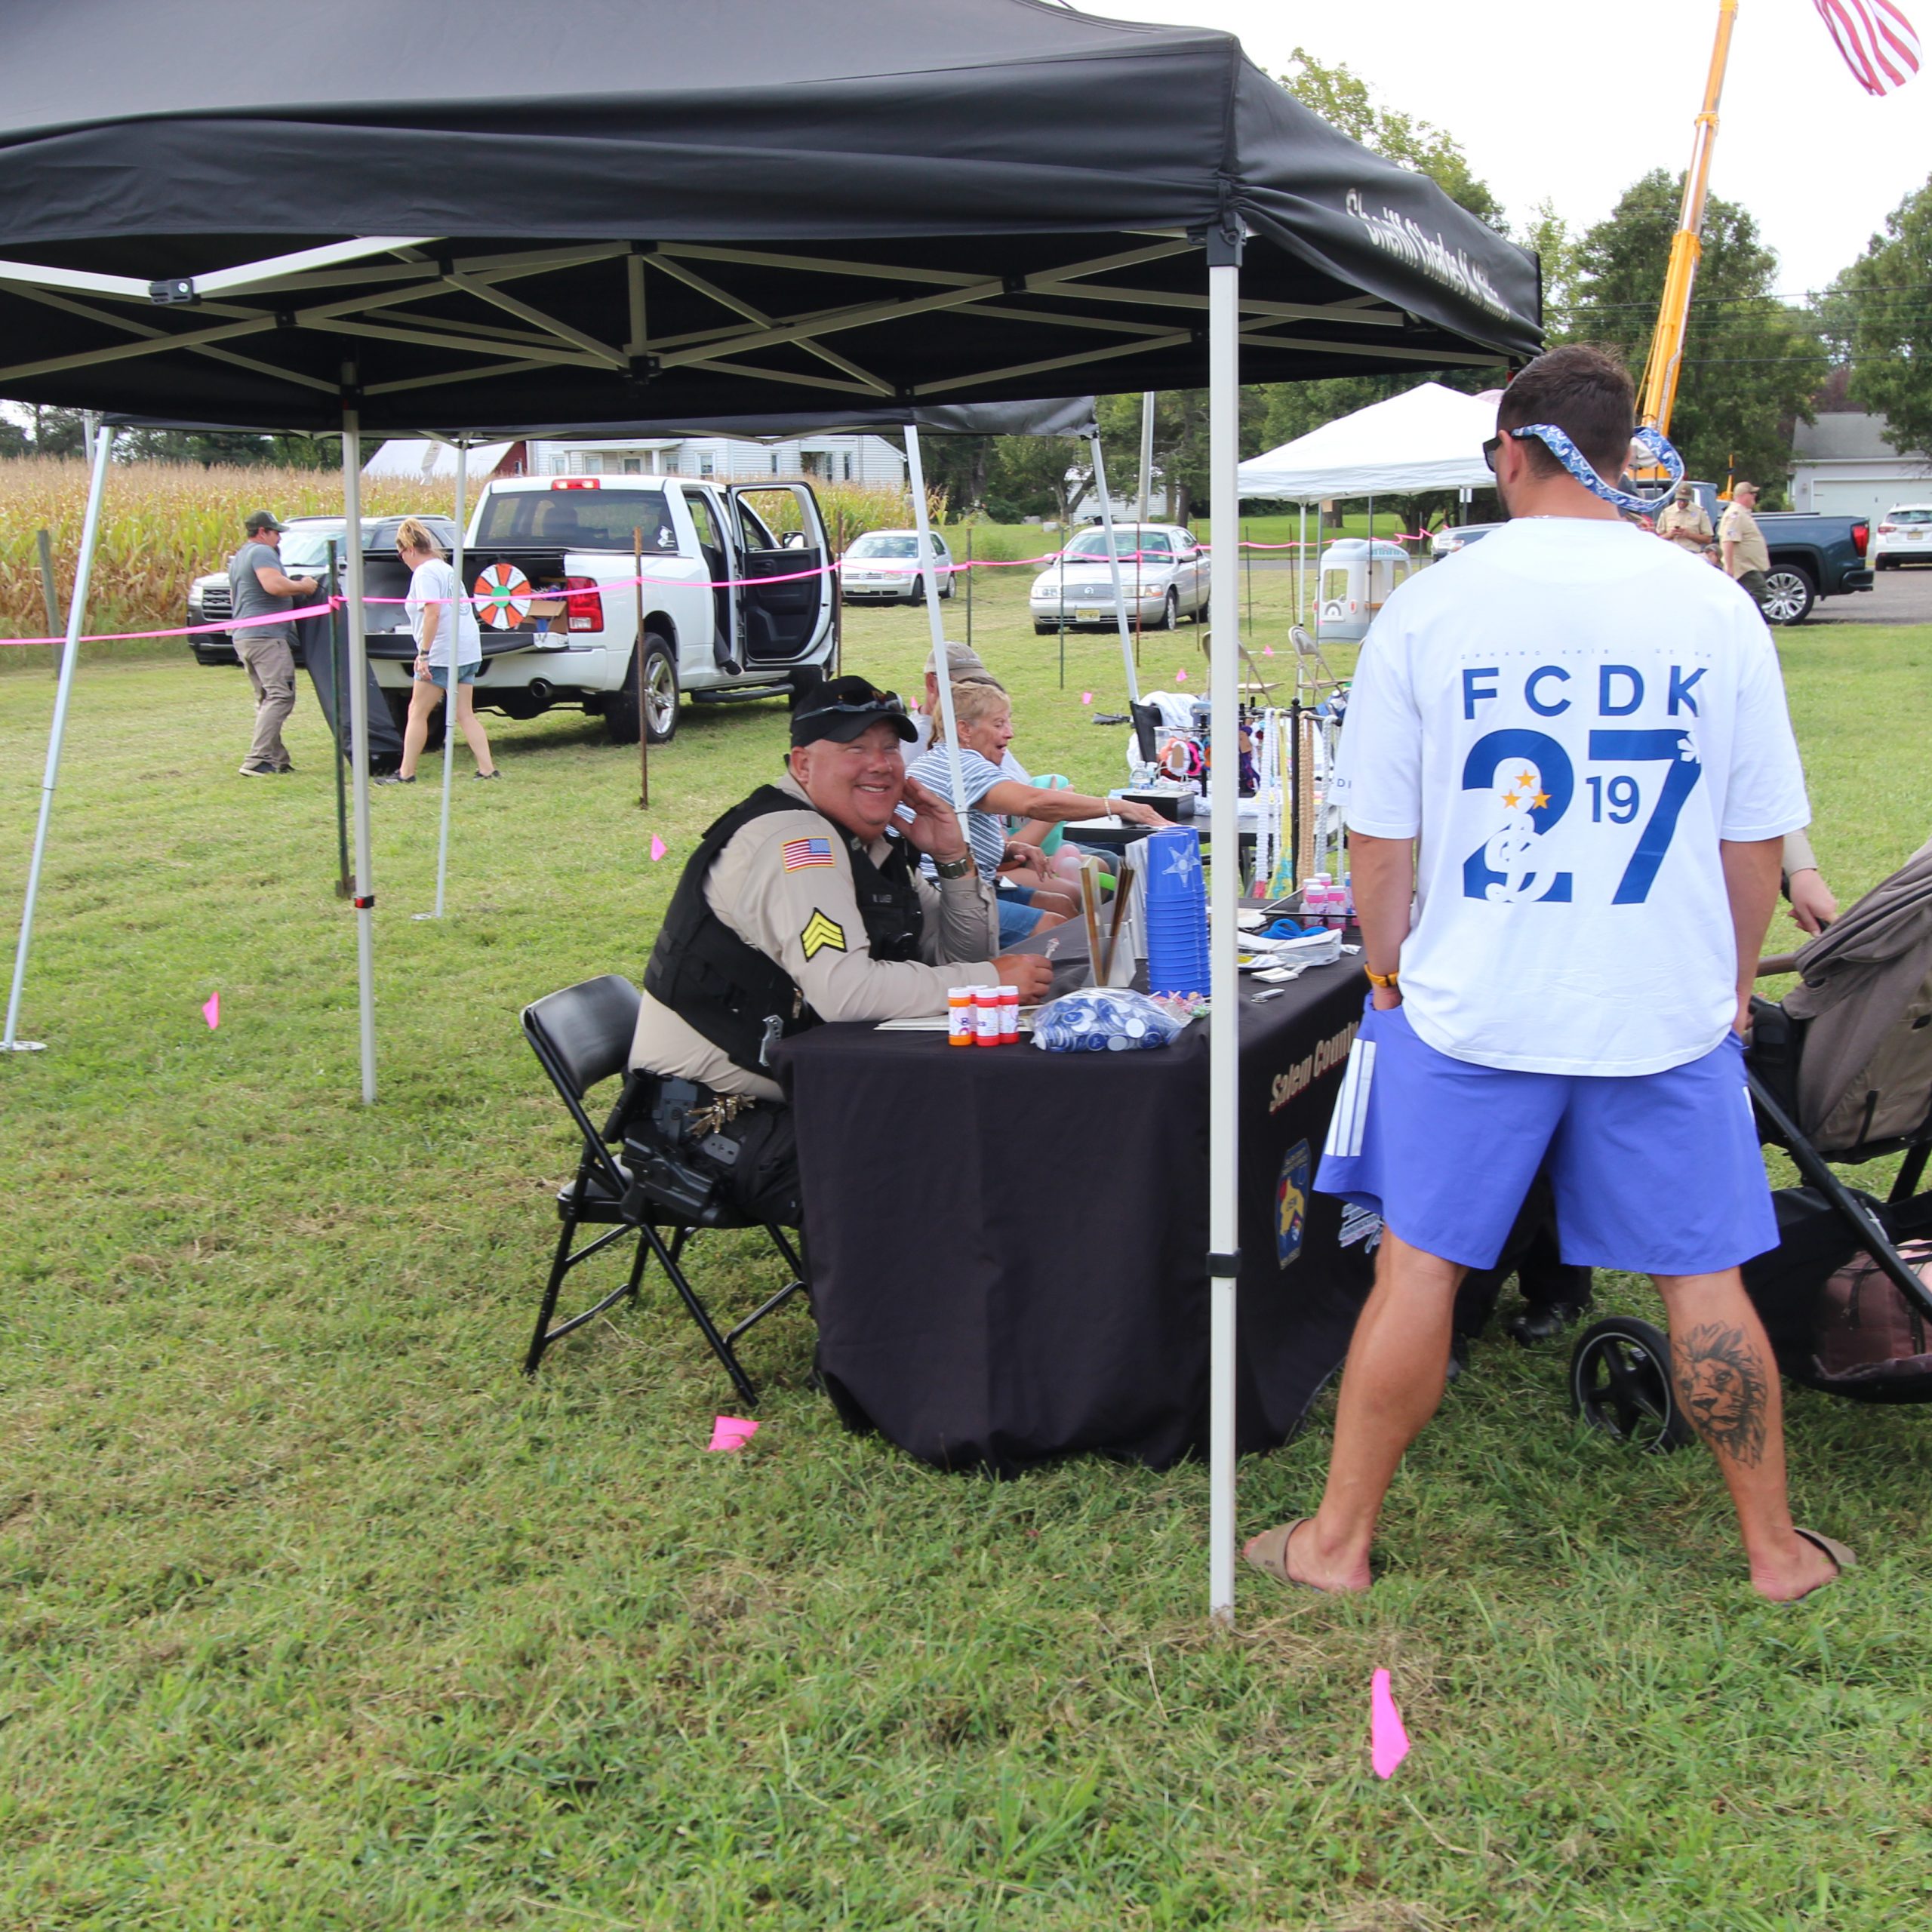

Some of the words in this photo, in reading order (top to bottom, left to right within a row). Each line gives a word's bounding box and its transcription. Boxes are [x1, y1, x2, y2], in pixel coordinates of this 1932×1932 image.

[1462, 664, 1709, 720] FCDK
[1585, 775, 1640, 824] 19
[1269, 1054, 1313, 1114] Salem
